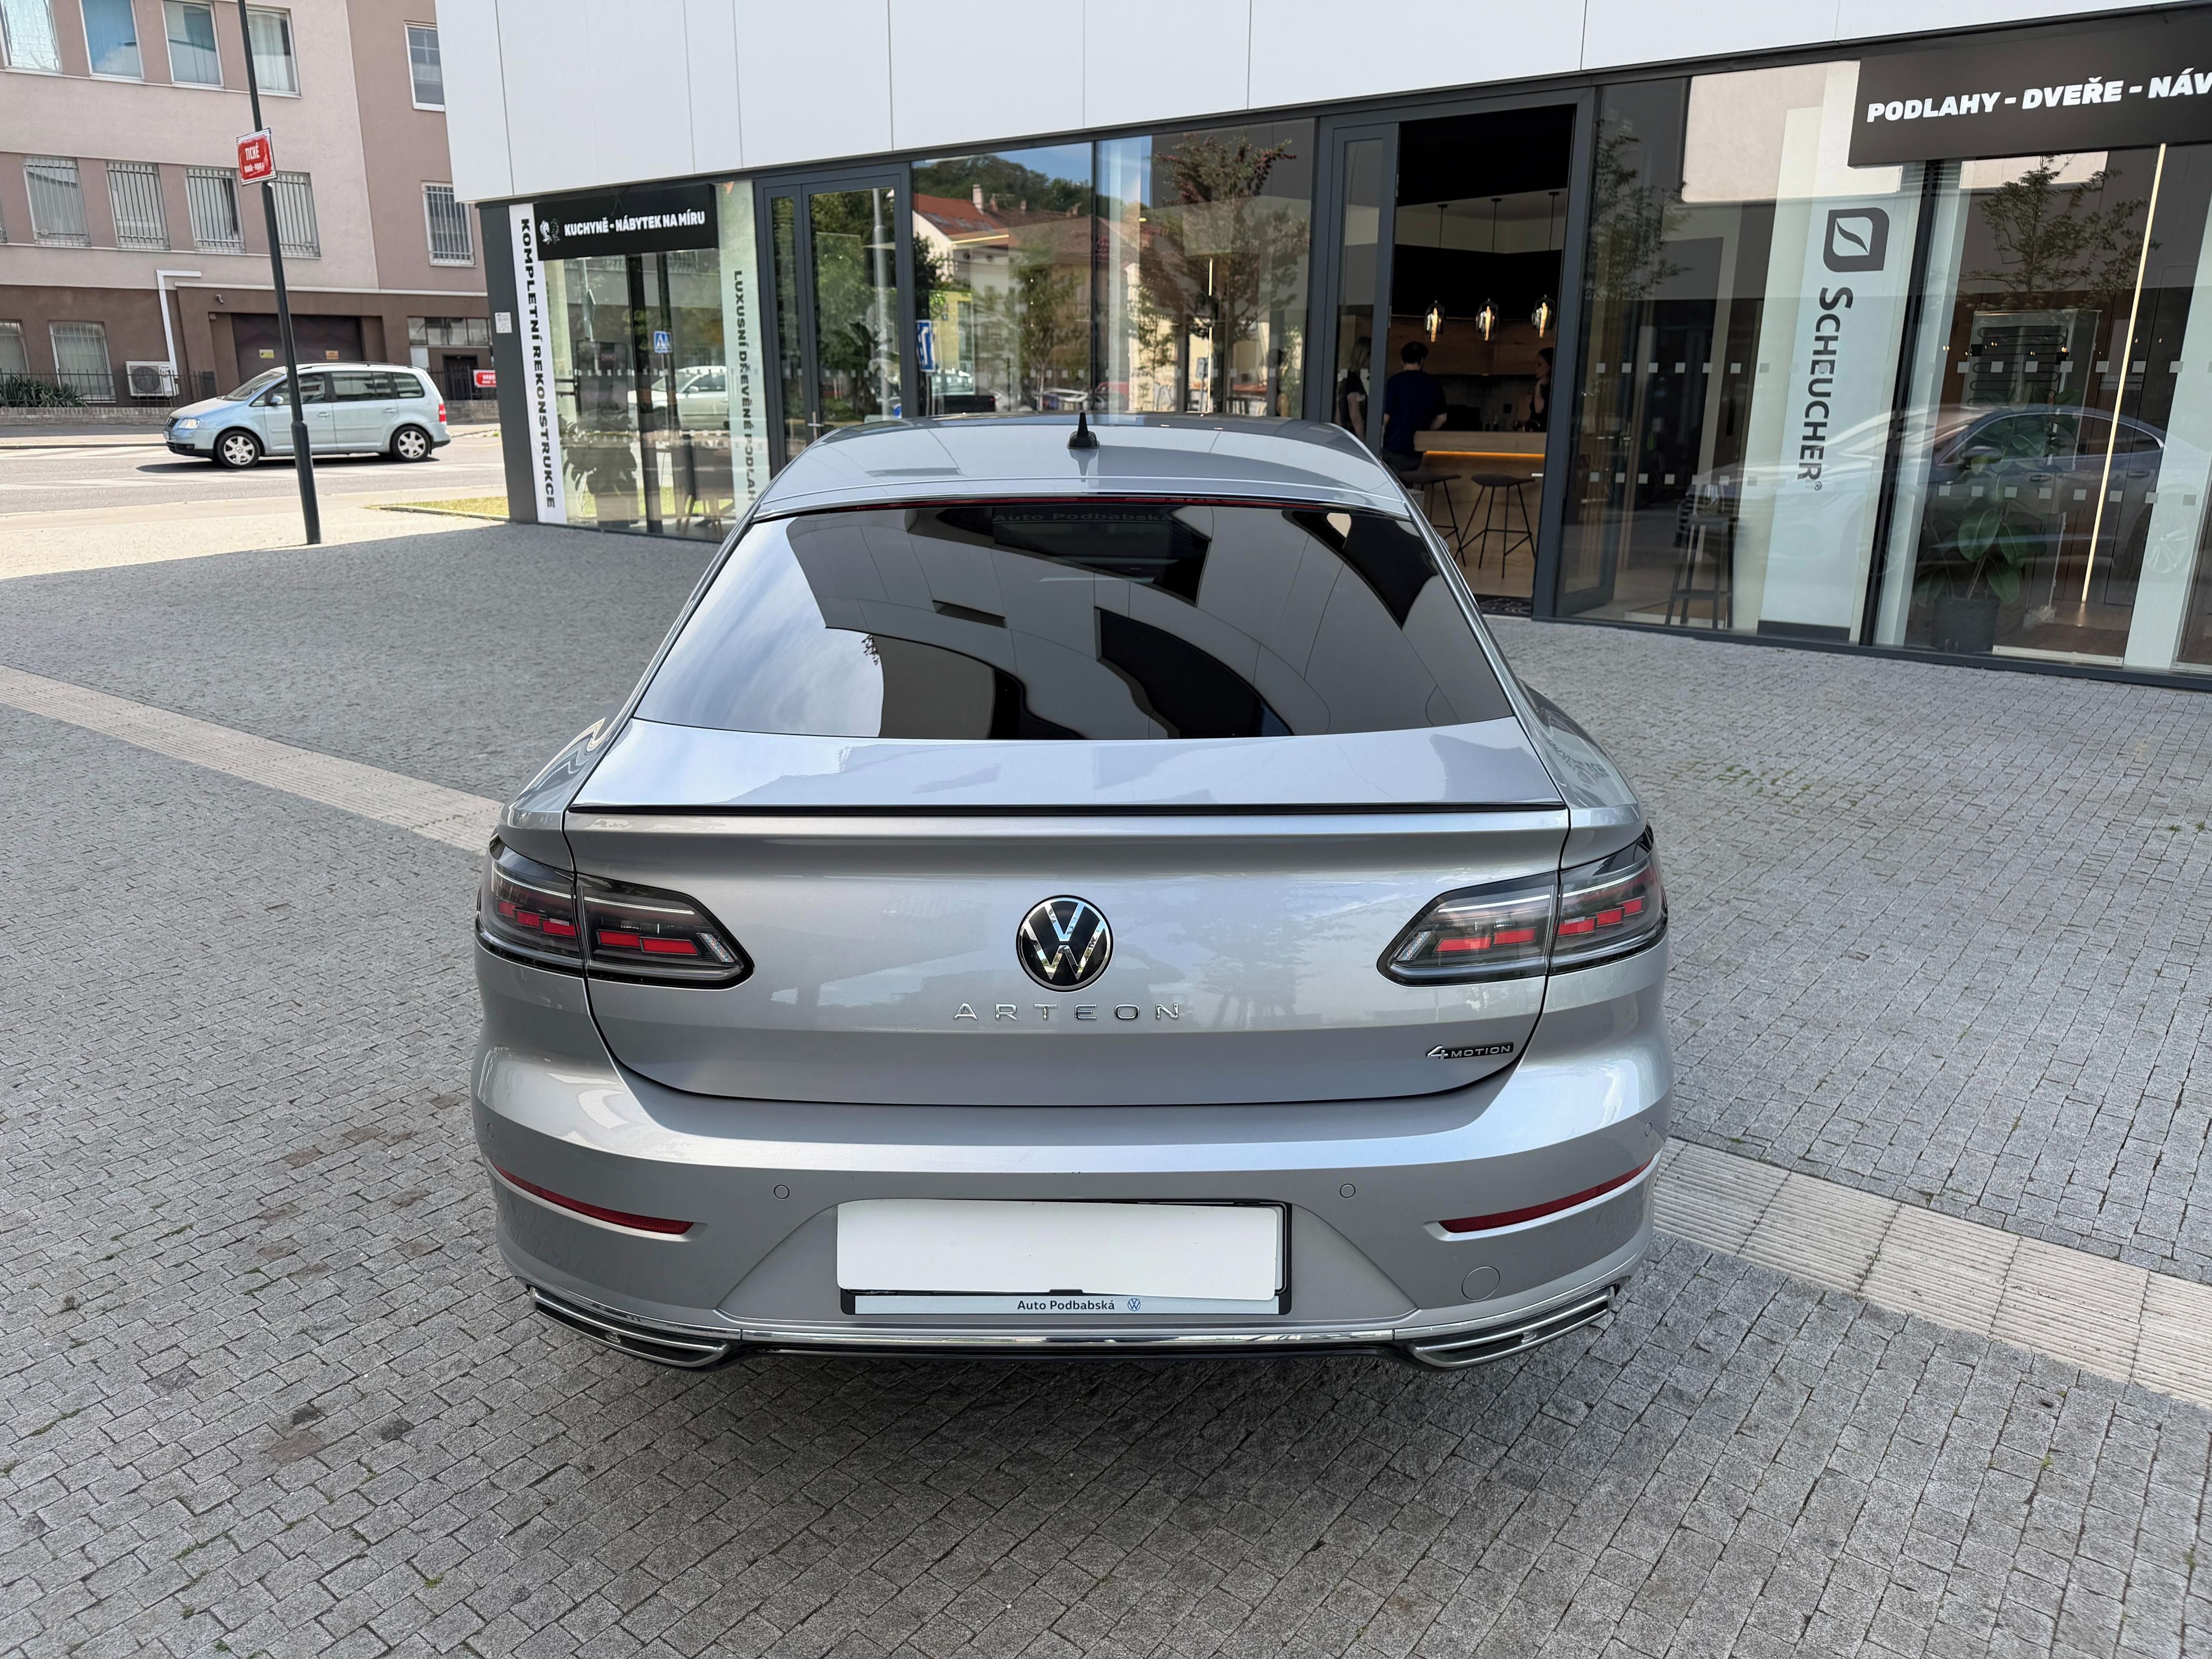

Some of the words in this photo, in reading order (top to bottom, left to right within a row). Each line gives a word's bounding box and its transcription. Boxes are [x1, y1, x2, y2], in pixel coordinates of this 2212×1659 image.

[1867, 91, 2001, 123] PODLAHY
[2022, 76, 2124, 109] DVEŘE
[564, 217, 609, 236] KUCHYNĚ
[615, 215, 662, 232] NÁBYTEK
[662, 214, 679, 227] NA
[678, 208, 705, 226] MÍRU
[734, 271, 749, 347] LUXUSNÍ
[521, 219, 543, 342] KOMPLETNÍ
[532, 346, 555, 508] REKONSTRUKCE
[739, 350, 754, 430] DŘEVĚNÉ
[953, 1002, 1179, 1021] ARTEON
[1427, 1045, 1511, 1060] 4MOTION
[1017, 1300, 1046, 1310] Auto
[1050, 1300, 1115, 1310] Podbabská
